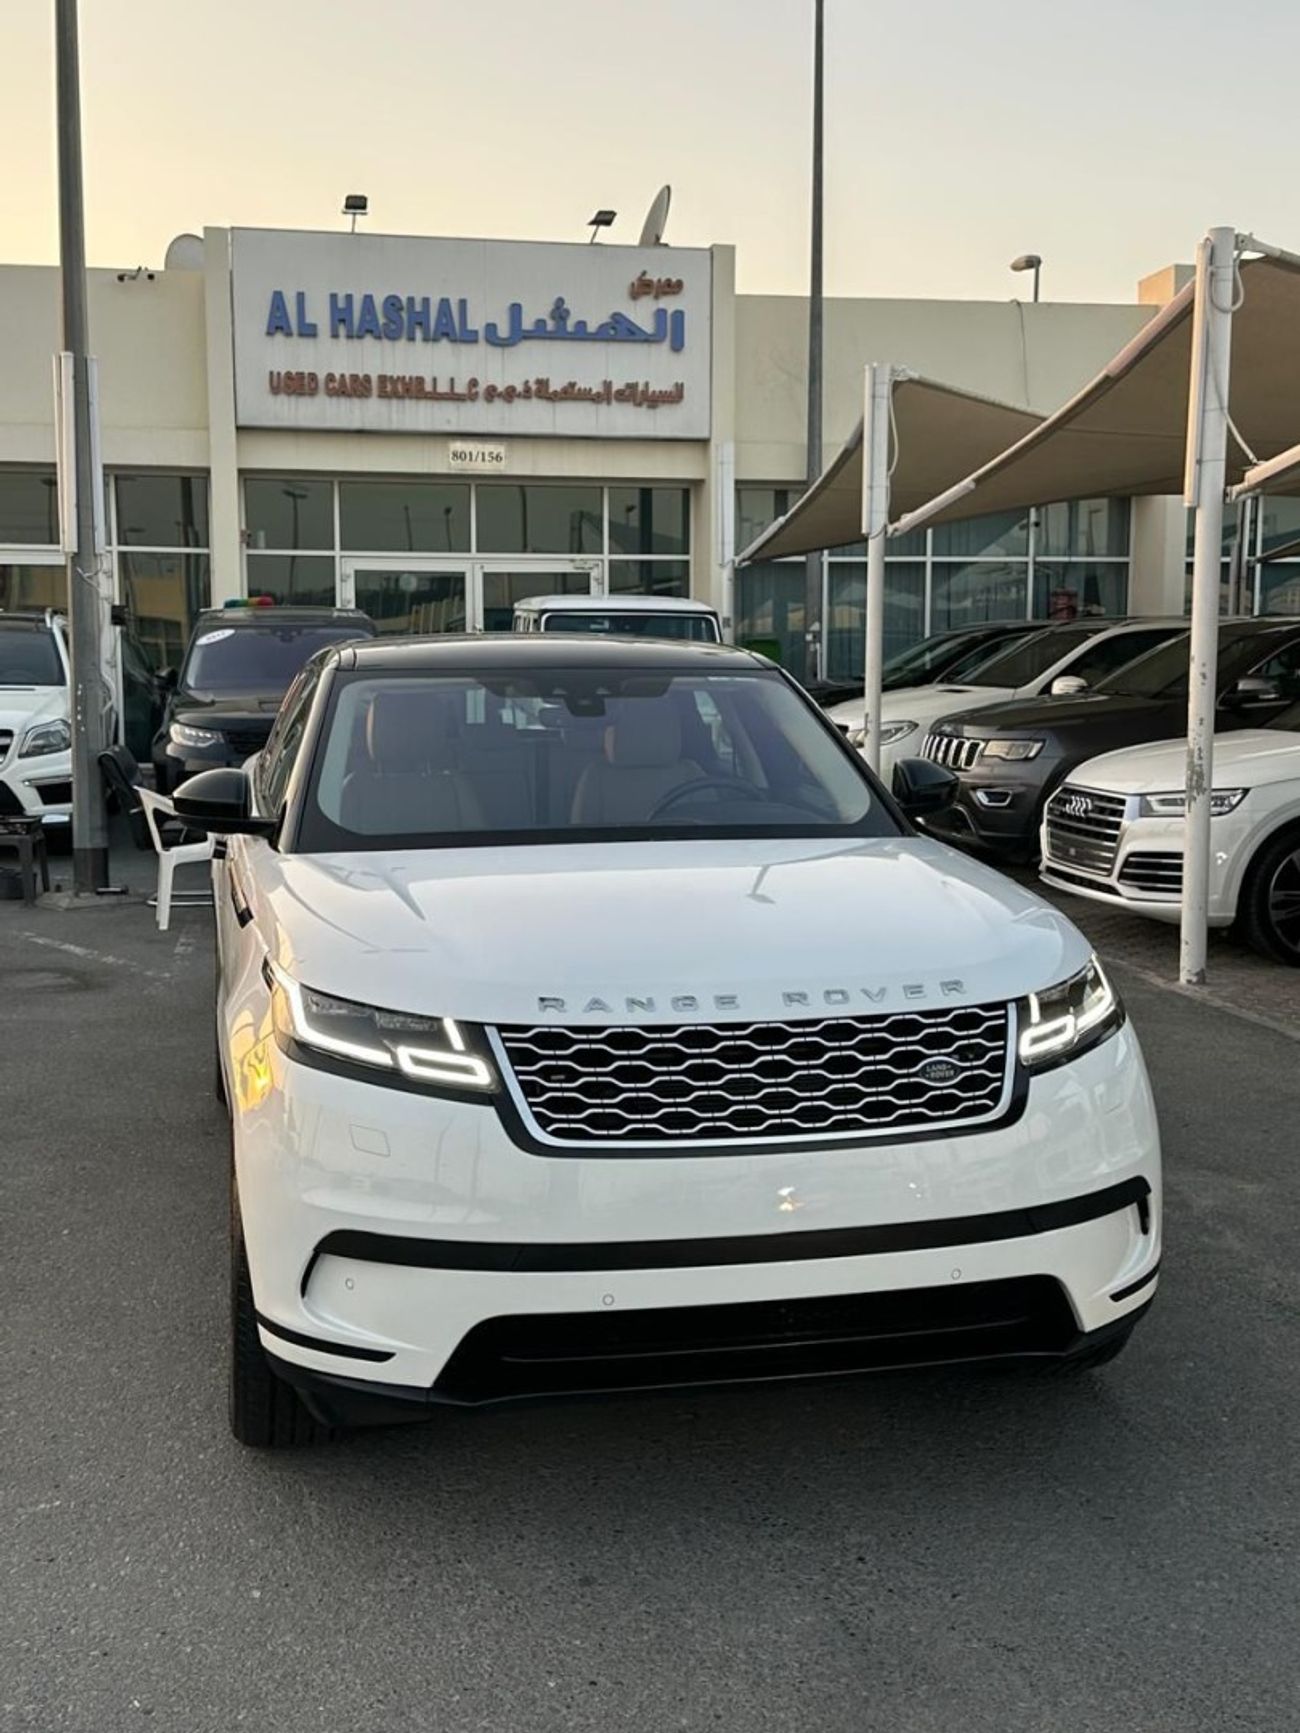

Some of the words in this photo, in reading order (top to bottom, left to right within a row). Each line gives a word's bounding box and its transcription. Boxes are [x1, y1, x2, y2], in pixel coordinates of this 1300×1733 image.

[629, 270, 684, 300] معرض
[266, 290, 318, 338] AL
[329, 292, 479, 344] HASHAL
[485, 296, 685, 352] الهشل
[269, 371, 319, 396] USED
[324, 372, 372, 398] CARS
[534, 377, 612, 406] المستعملة
[451, 450, 503, 463] 801/156
[538, 995, 740, 1013] RANGE
[782, 979, 966, 1007] ROVER
